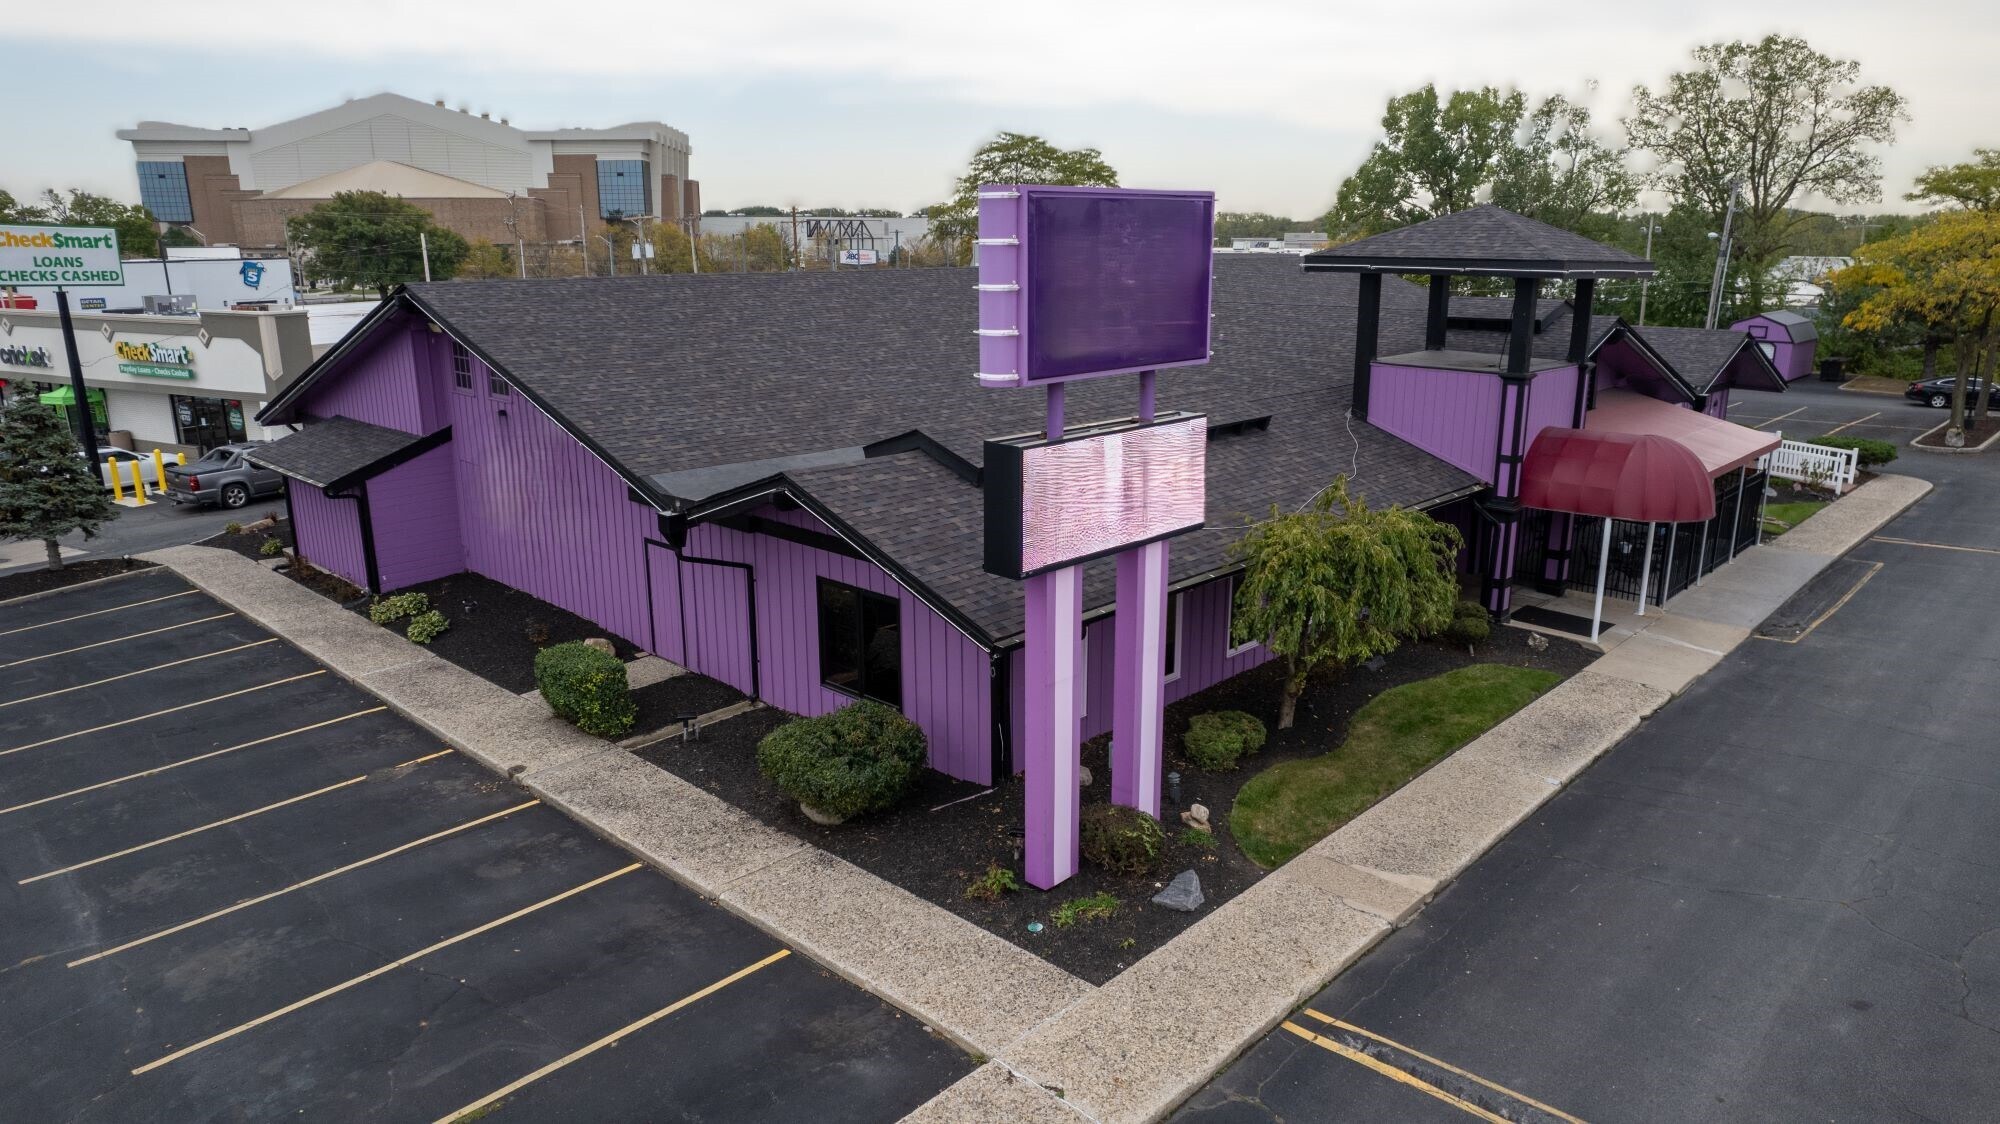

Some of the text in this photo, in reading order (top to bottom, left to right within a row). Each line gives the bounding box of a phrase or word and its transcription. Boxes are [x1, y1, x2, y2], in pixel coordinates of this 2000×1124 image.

[33, 256, 84, 268] LOANS
[0, 270, 120, 281] CHECKS CASHED
[120, 365, 137, 374] Payday
[154, 368, 171, 376] Checks
